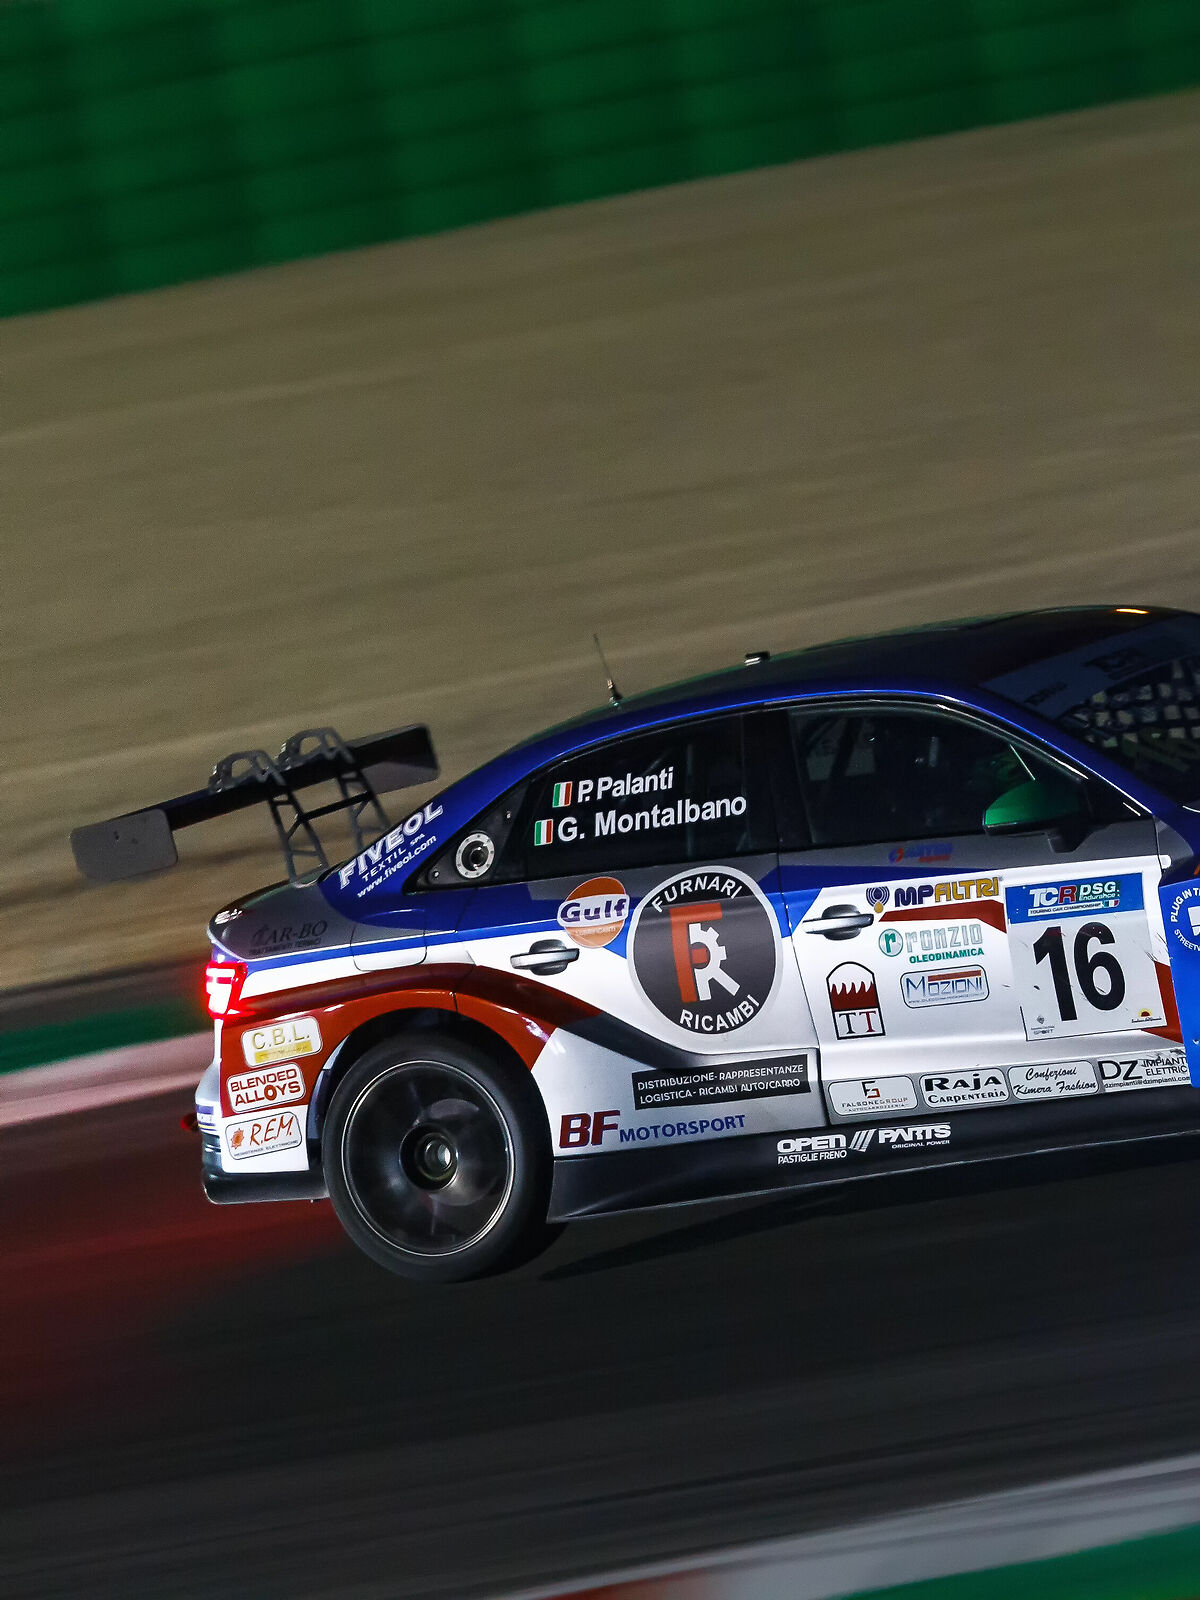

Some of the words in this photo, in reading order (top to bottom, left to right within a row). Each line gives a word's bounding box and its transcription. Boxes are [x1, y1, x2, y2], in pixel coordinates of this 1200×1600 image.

[597, 766, 674, 800] Palanti
[557, 817, 586, 842] G.
[594, 796, 747, 837] Montalbano
[339, 802, 444, 890] FIVEOL
[362, 848, 406, 882] TEXTIL
[651, 876, 743, 913] FURNARI
[1029, 884, 1077, 908] TCR
[1064, 902, 1101, 910] CHAMPIONSHIP
[1170, 896, 1184, 922] PLUG
[1182, 889, 1192, 899] IN
[560, 898, 627, 923] Gulf
[909, 947, 985, 964] OLEODINAMICA
[1033, 921, 1126, 1022] 16
[680, 994, 760, 1032] RICAMBI
[251, 1023, 310, 1050] C.B.L.
[719, 1064, 804, 1081] RAPPRESENTANZE
[1025, 1066, 1077, 1082] Confezioni
[1098, 1060, 1143, 1081] DZ
[1143, 1056, 1187, 1068] IMPIANT
[1145, 1065, 1188, 1076] ELETTRIC
[230, 1068, 298, 1093] BLENDED
[699, 1085, 738, 1097] RICAMBI
[1013, 1084, 1052, 1096] Kimera
[1056, 1080, 1097, 1094] Fashion
[235, 1081, 301, 1106] ALLOYS
[558, 1110, 621, 1149] BF
[619, 1114, 746, 1143] MOTORSPORT
[776, 1134, 847, 1153] OPEN
[878, 1124, 951, 1144] PARTS
[777, 1151, 819, 1164] PASTIGLIE
[819, 1149, 847, 1160] FRENO
